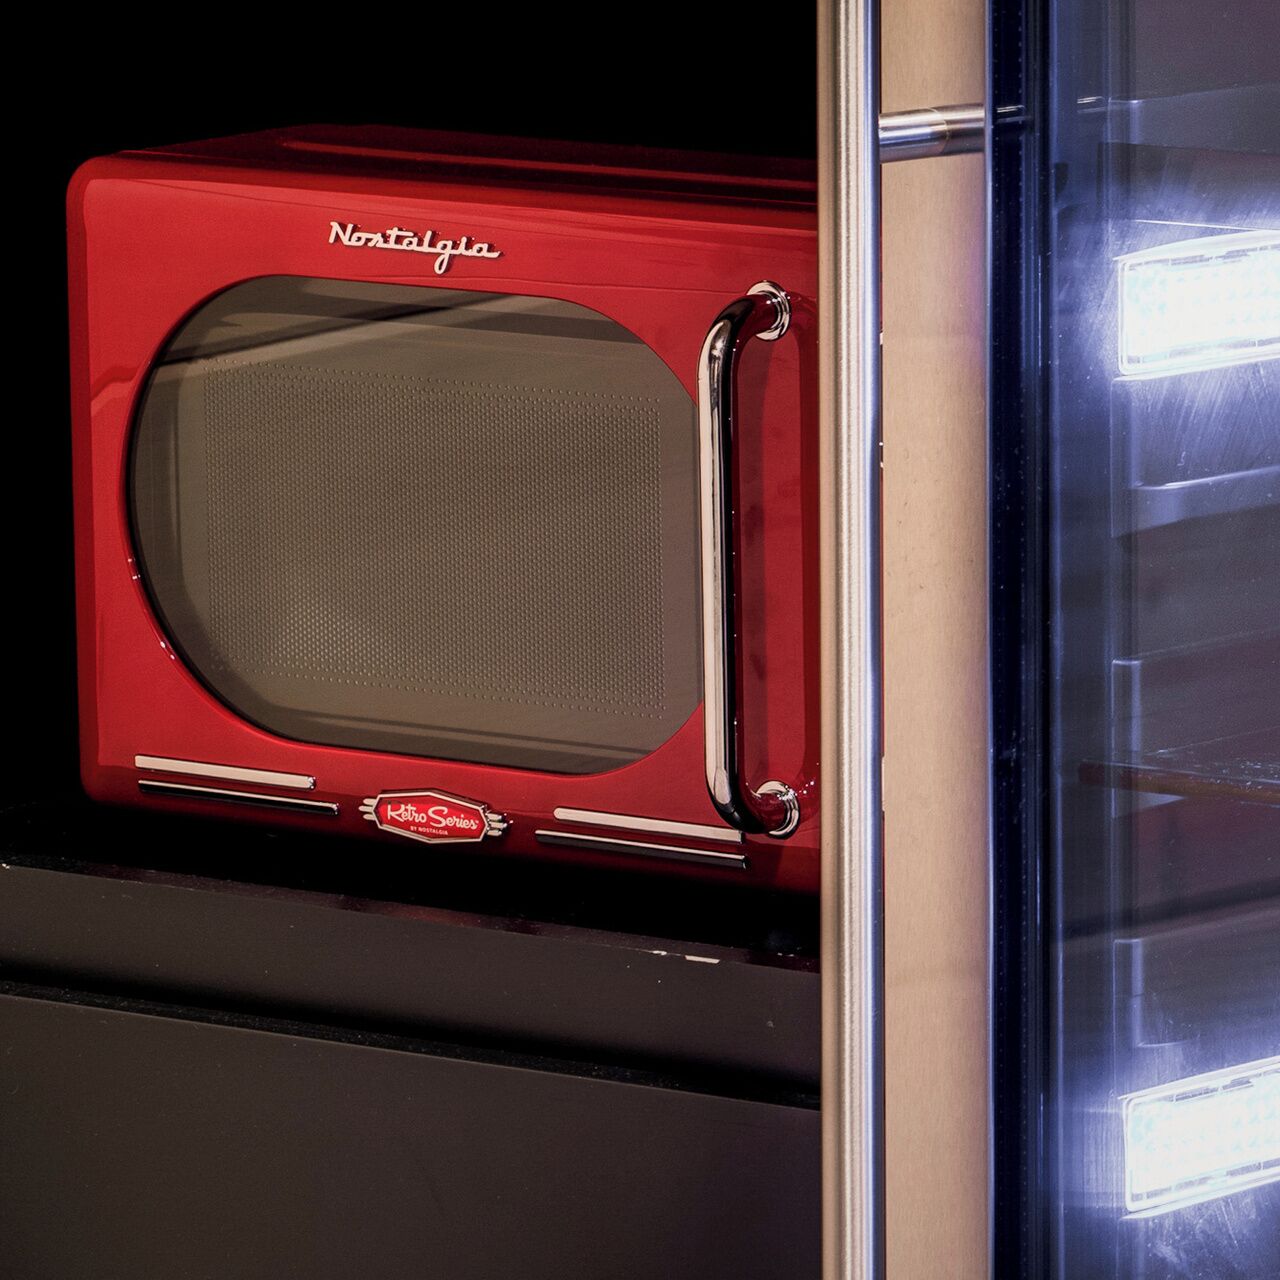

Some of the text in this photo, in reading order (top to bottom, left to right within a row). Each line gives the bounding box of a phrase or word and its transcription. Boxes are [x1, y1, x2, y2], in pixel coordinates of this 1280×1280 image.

[328, 221, 501, 274] Nostalgia
[387, 803, 480, 830] Retro Series
[418, 827, 448, 836] NOSTALGIA
